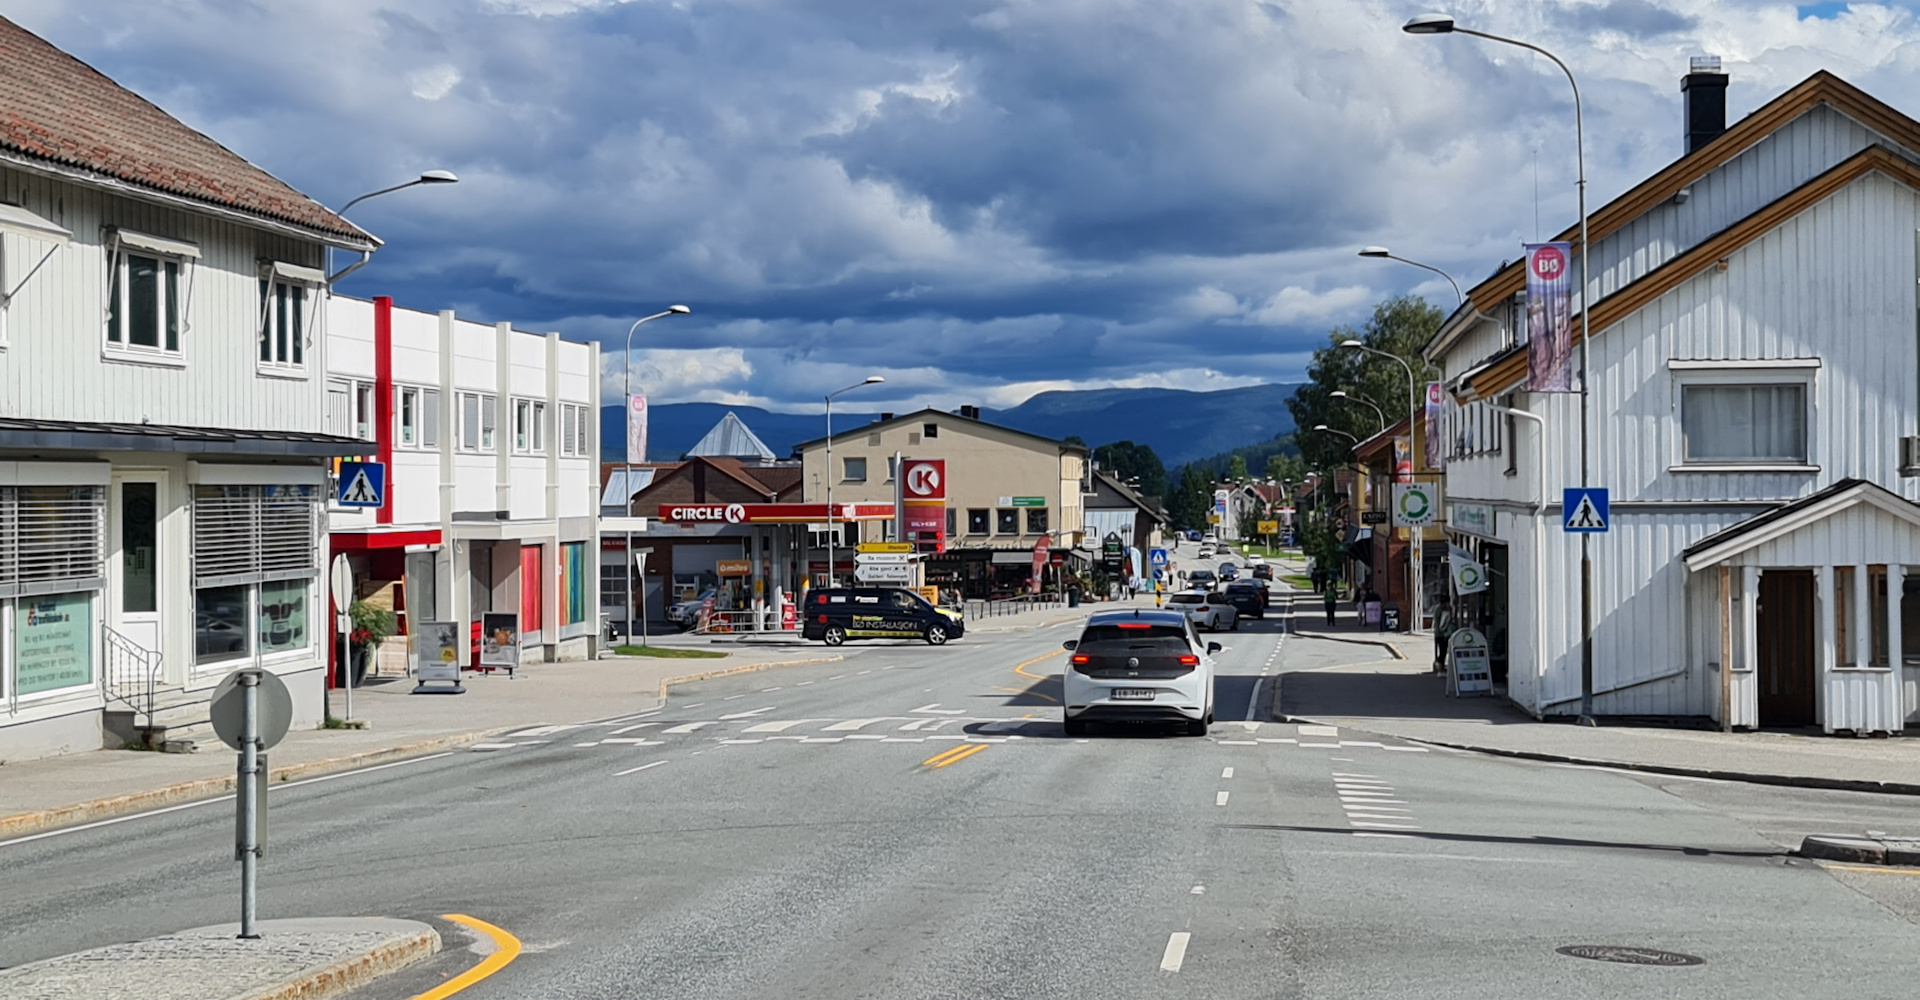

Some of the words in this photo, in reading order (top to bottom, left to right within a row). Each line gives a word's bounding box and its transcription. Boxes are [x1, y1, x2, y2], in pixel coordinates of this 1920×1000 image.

[1538, 258, 1559, 273] BØ
[912, 466, 939, 495] K
[671, 507, 723, 520] CIRCLE
[727, 504, 744, 523] K
